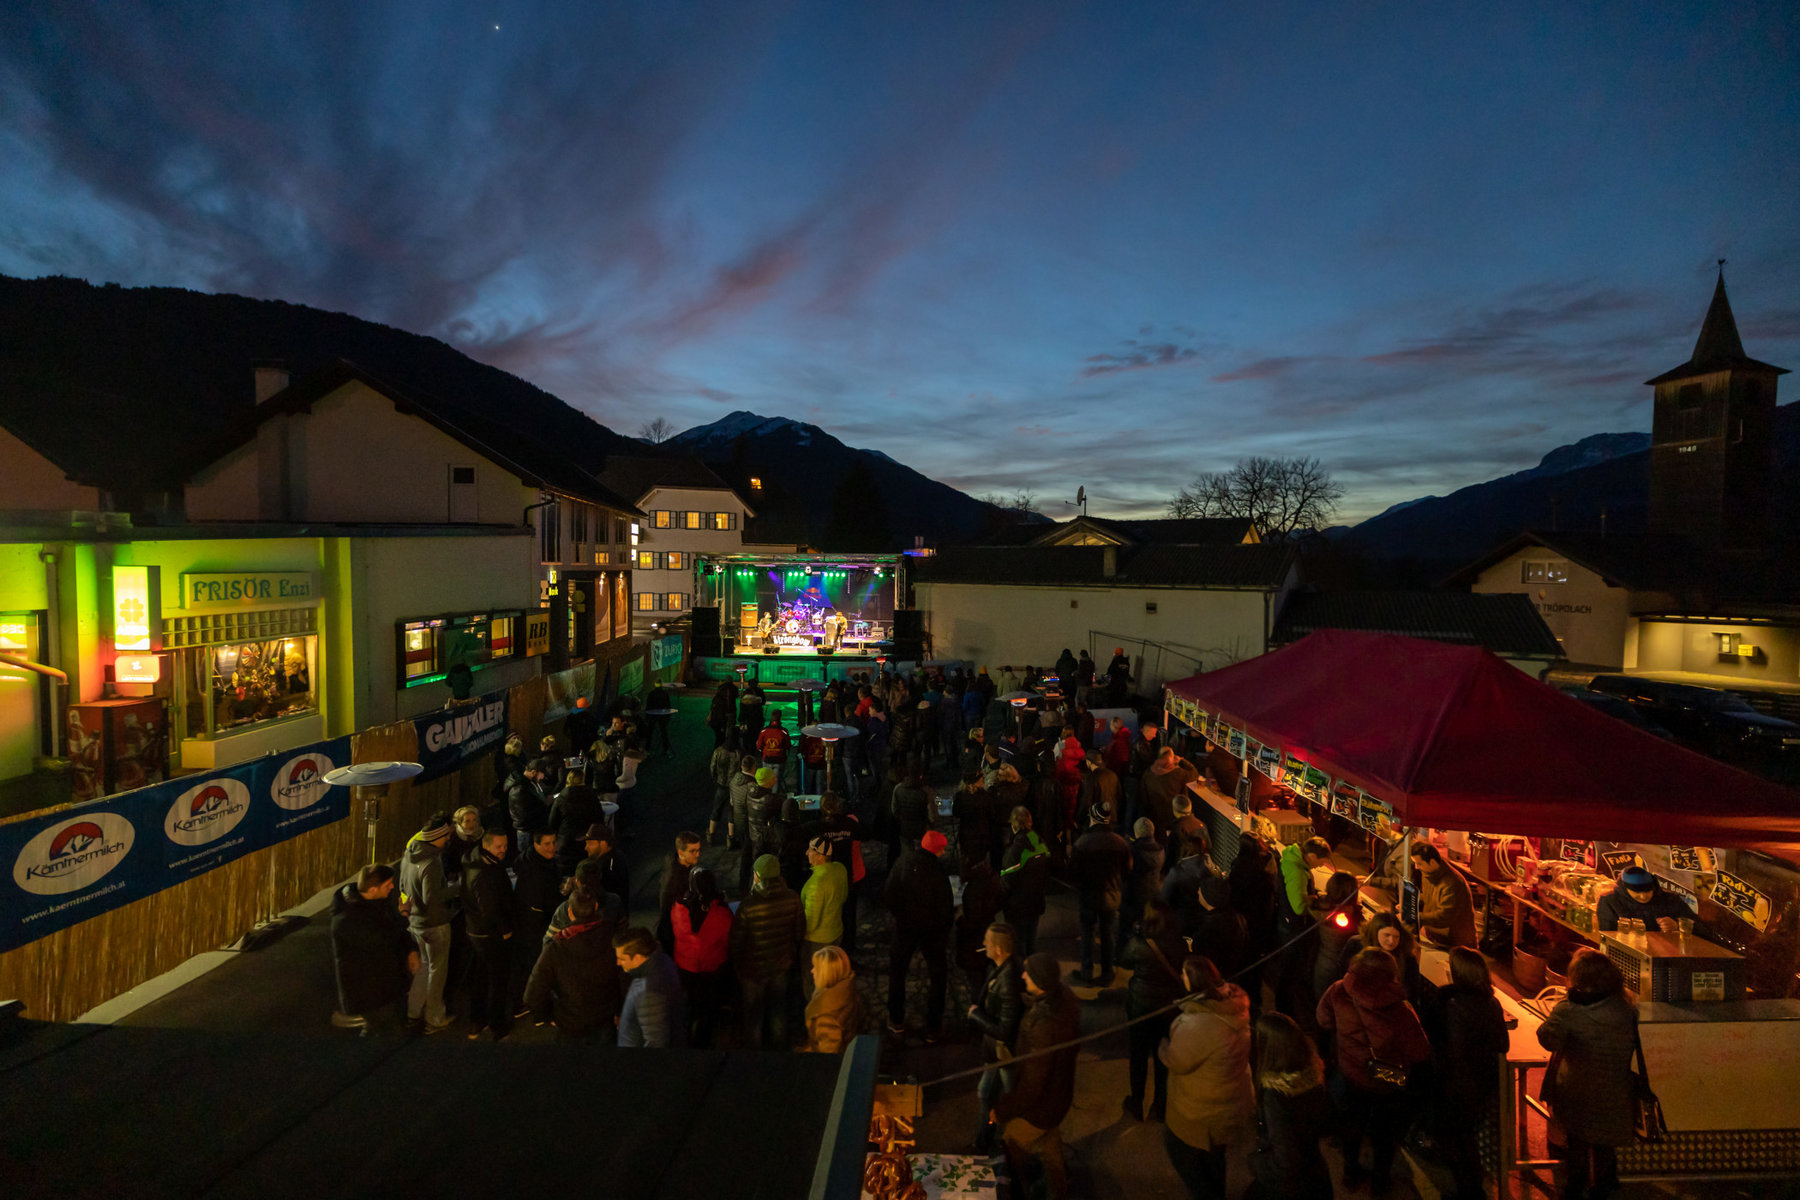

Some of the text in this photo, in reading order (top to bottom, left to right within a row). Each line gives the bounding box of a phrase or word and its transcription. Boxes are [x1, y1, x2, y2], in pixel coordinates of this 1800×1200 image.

[193, 577, 310, 602] FRISÖR Enzi
[173, 803, 244, 833] Kärntnermilch
[26, 841, 125, 880] Kärntnermilch
[21, 880, 126, 924] www.kaerntnermilch.at
